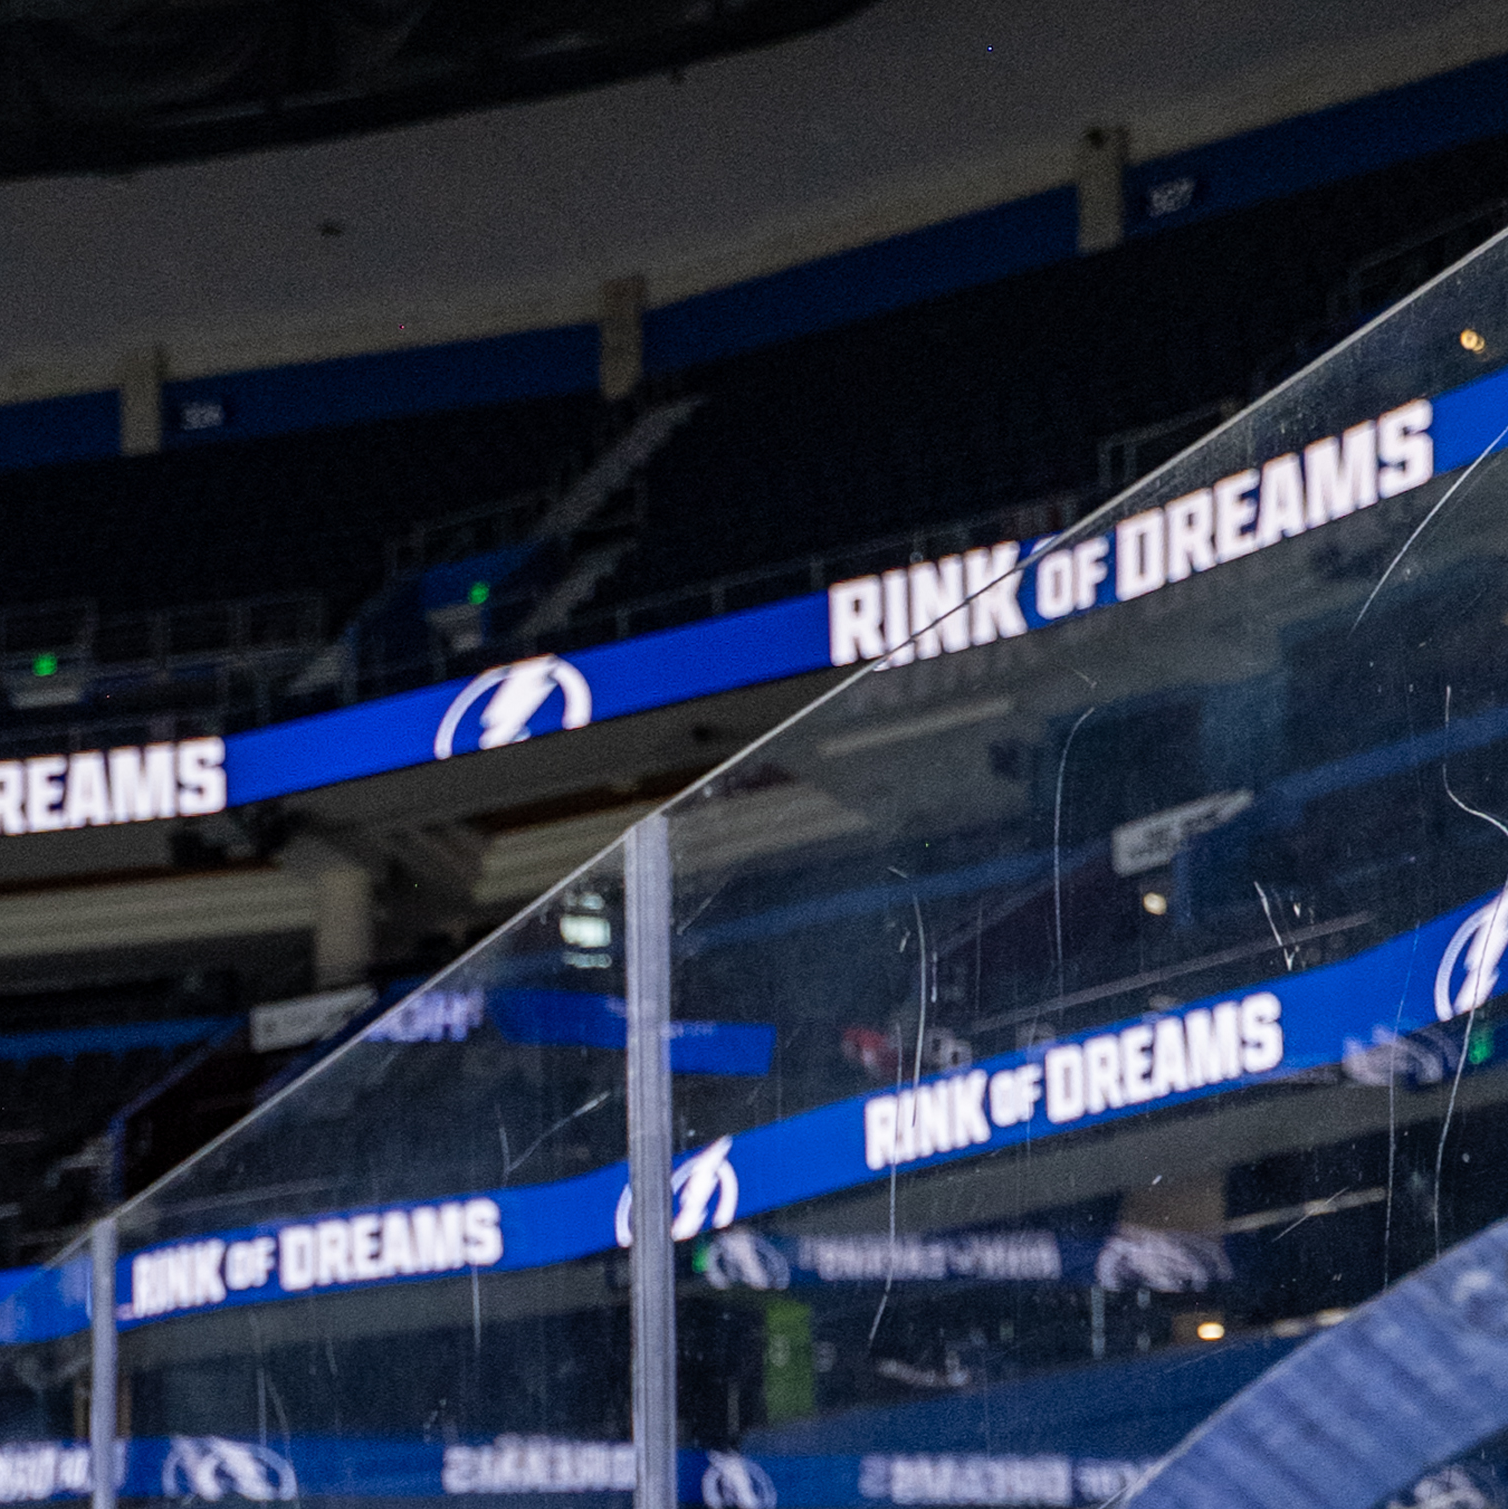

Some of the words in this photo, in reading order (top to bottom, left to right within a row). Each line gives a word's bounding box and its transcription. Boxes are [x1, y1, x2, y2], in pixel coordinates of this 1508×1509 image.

[829, 540, 1029, 669] RINK
[1035, 536, 1109, 622] OF
[1114, 398, 1435, 602] DREAMS
[864, 1066, 991, 1171] RINK
[990, 1062, 1043, 1128] OF
[1044, 990, 1285, 1124] DREAMS
[132, 1236, 227, 1317] RINK
[226, 1235, 276, 1293] OF
[277, 1198, 504, 1293] DREAMS
